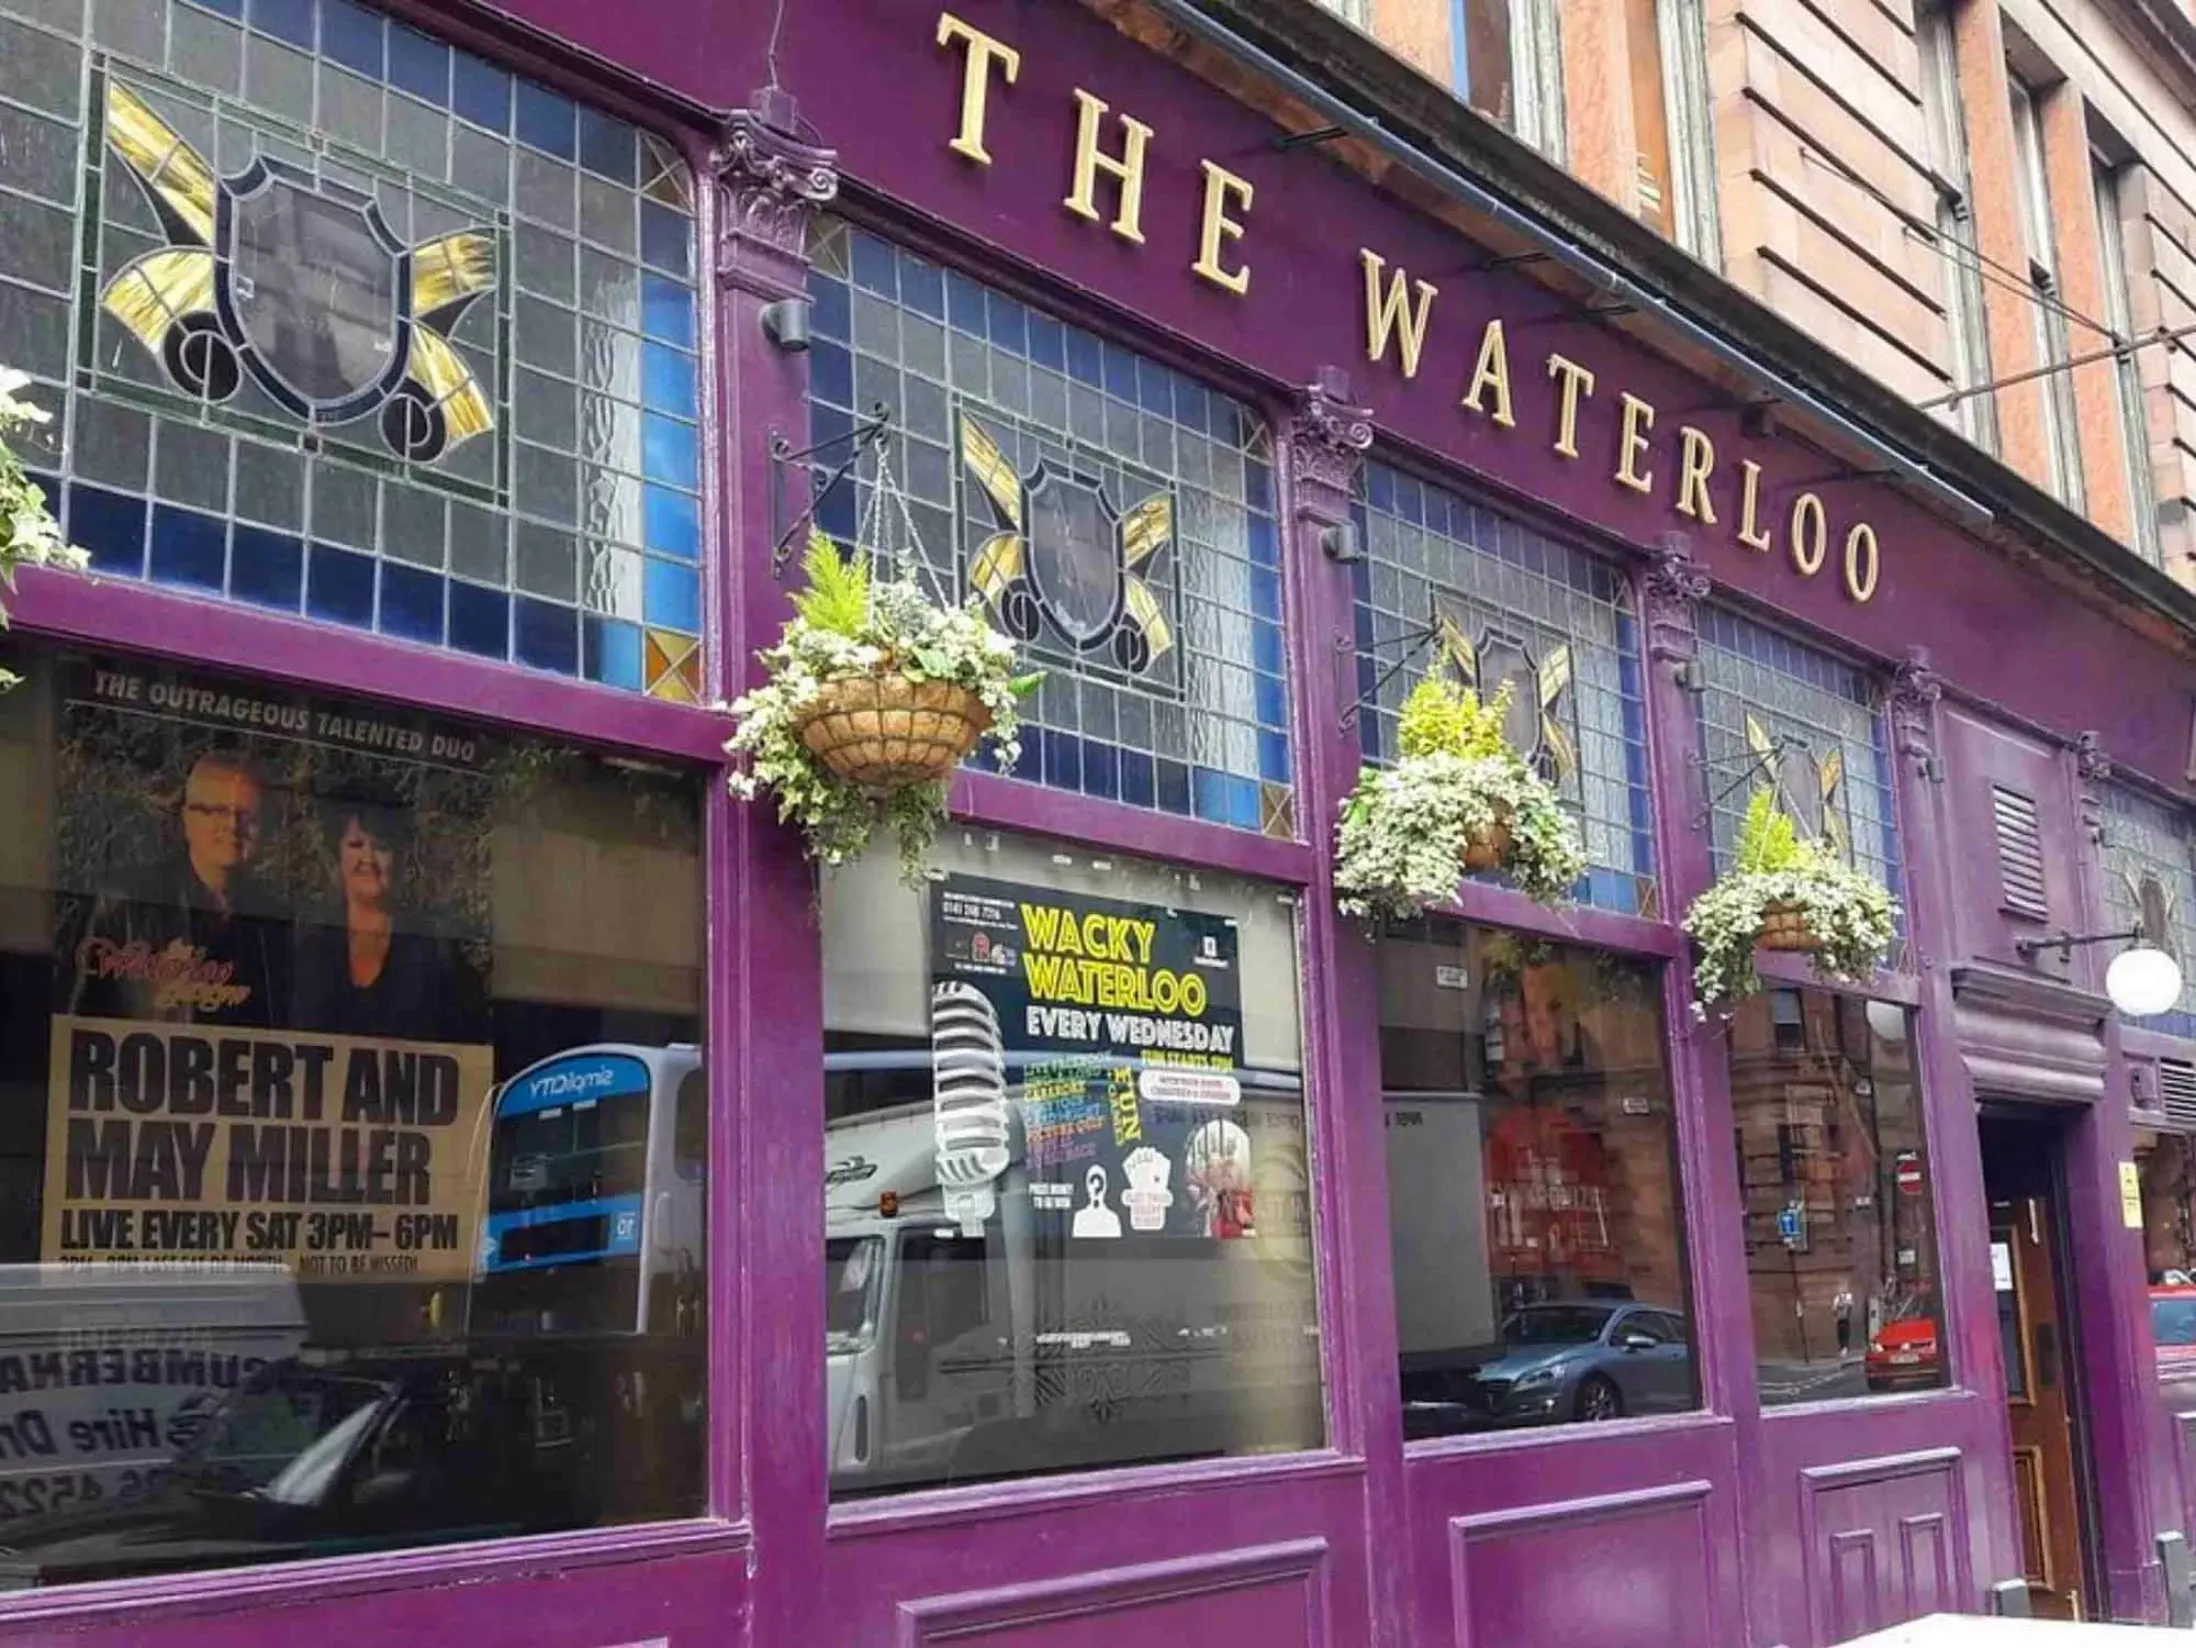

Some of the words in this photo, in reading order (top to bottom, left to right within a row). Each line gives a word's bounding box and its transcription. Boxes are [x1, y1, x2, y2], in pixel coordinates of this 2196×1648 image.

[937, 12, 1254, 295] THE
[1361, 247, 1879, 602] WATERLOO
[96, 672, 141, 701] THE
[149, 683, 310, 730] OUTRAGEOUS
[317, 712, 421, 751] TALENTED
[431, 737, 475, 763] DUO
[1021, 903, 1156, 964] WACKY
[1022, 952, 1207, 1017] WATERLOO
[1026, 1005, 1101, 1041] EVERY
[1106, 1013, 1235, 1053] WEDNESDAY
[70, 1029, 333, 1119] ROBERT
[342, 1049, 459, 1126] AND
[66, 1119, 216, 1201] MAY
[226, 1124, 430, 1206] MILLER
[61, 1210, 134, 1249] LIVE
[142, 1211, 240, 1249] EVERY
[246, 1212, 301, 1249] SAT
[299, 1254, 325, 1275] NOT
[328, 1254, 346, 1275] TO
[350, 1254, 367, 1275] BE
